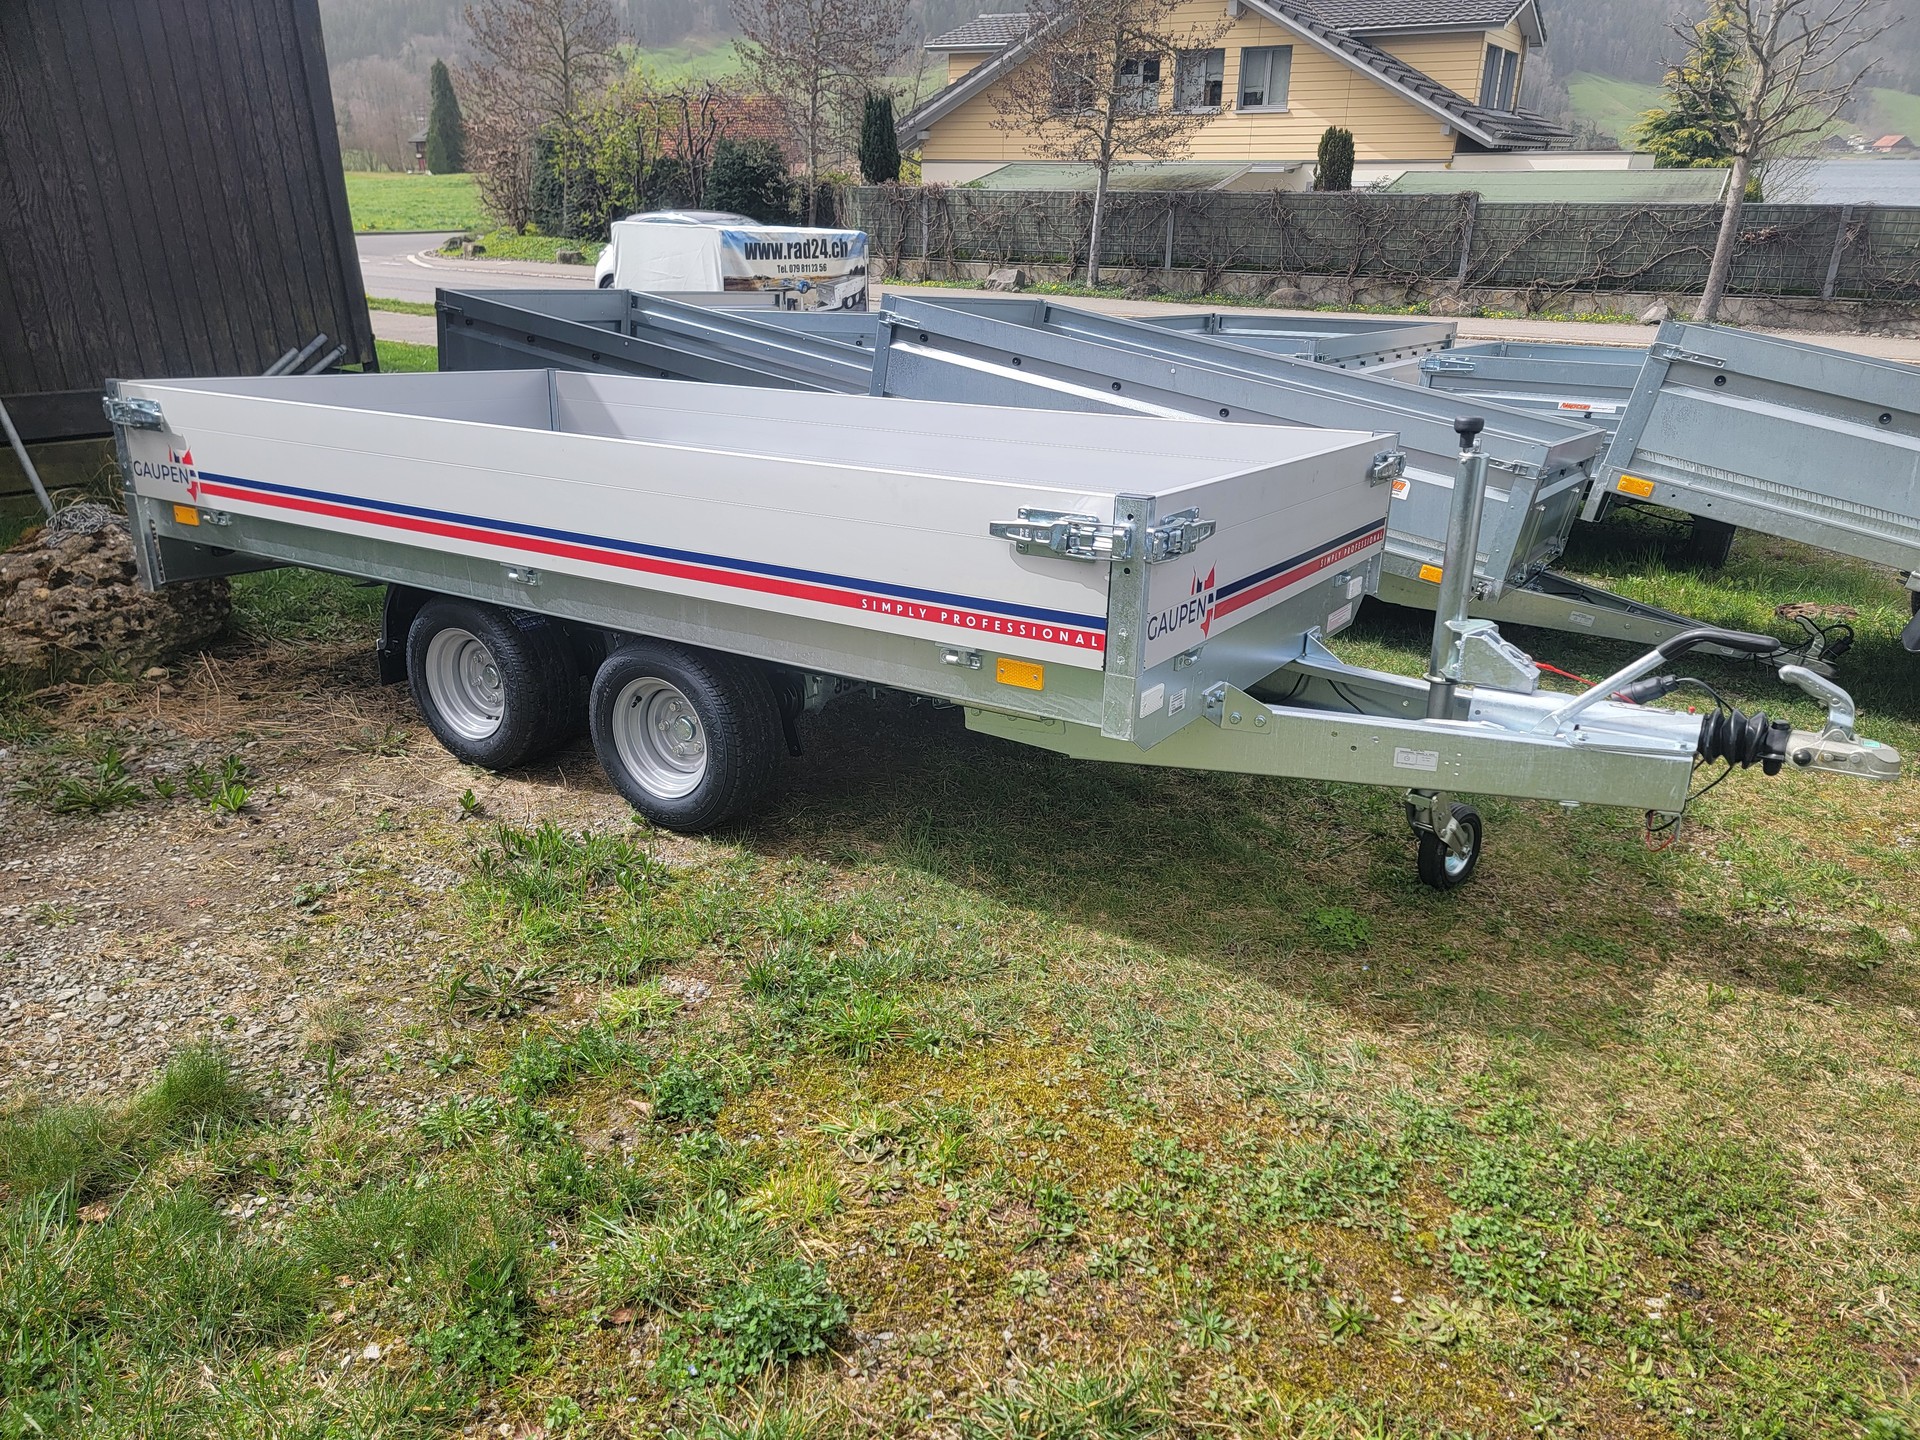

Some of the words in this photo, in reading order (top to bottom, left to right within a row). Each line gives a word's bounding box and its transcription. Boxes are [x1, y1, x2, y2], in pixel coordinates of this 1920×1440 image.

[744, 238, 849, 260] www.rad24.ch
[789, 264, 800, 273] 079
[819, 263, 828, 272] 56
[133, 460, 190, 484] GAUPEN
[1320, 551, 1342, 568] SIMPLY
[1344, 531, 1383, 556] PROFESSIONAL
[861, 598, 928, 618] SIMPLY
[941, 611, 1098, 647] PROFESSIONAL
[1147, 595, 1206, 641] GAUPEN
